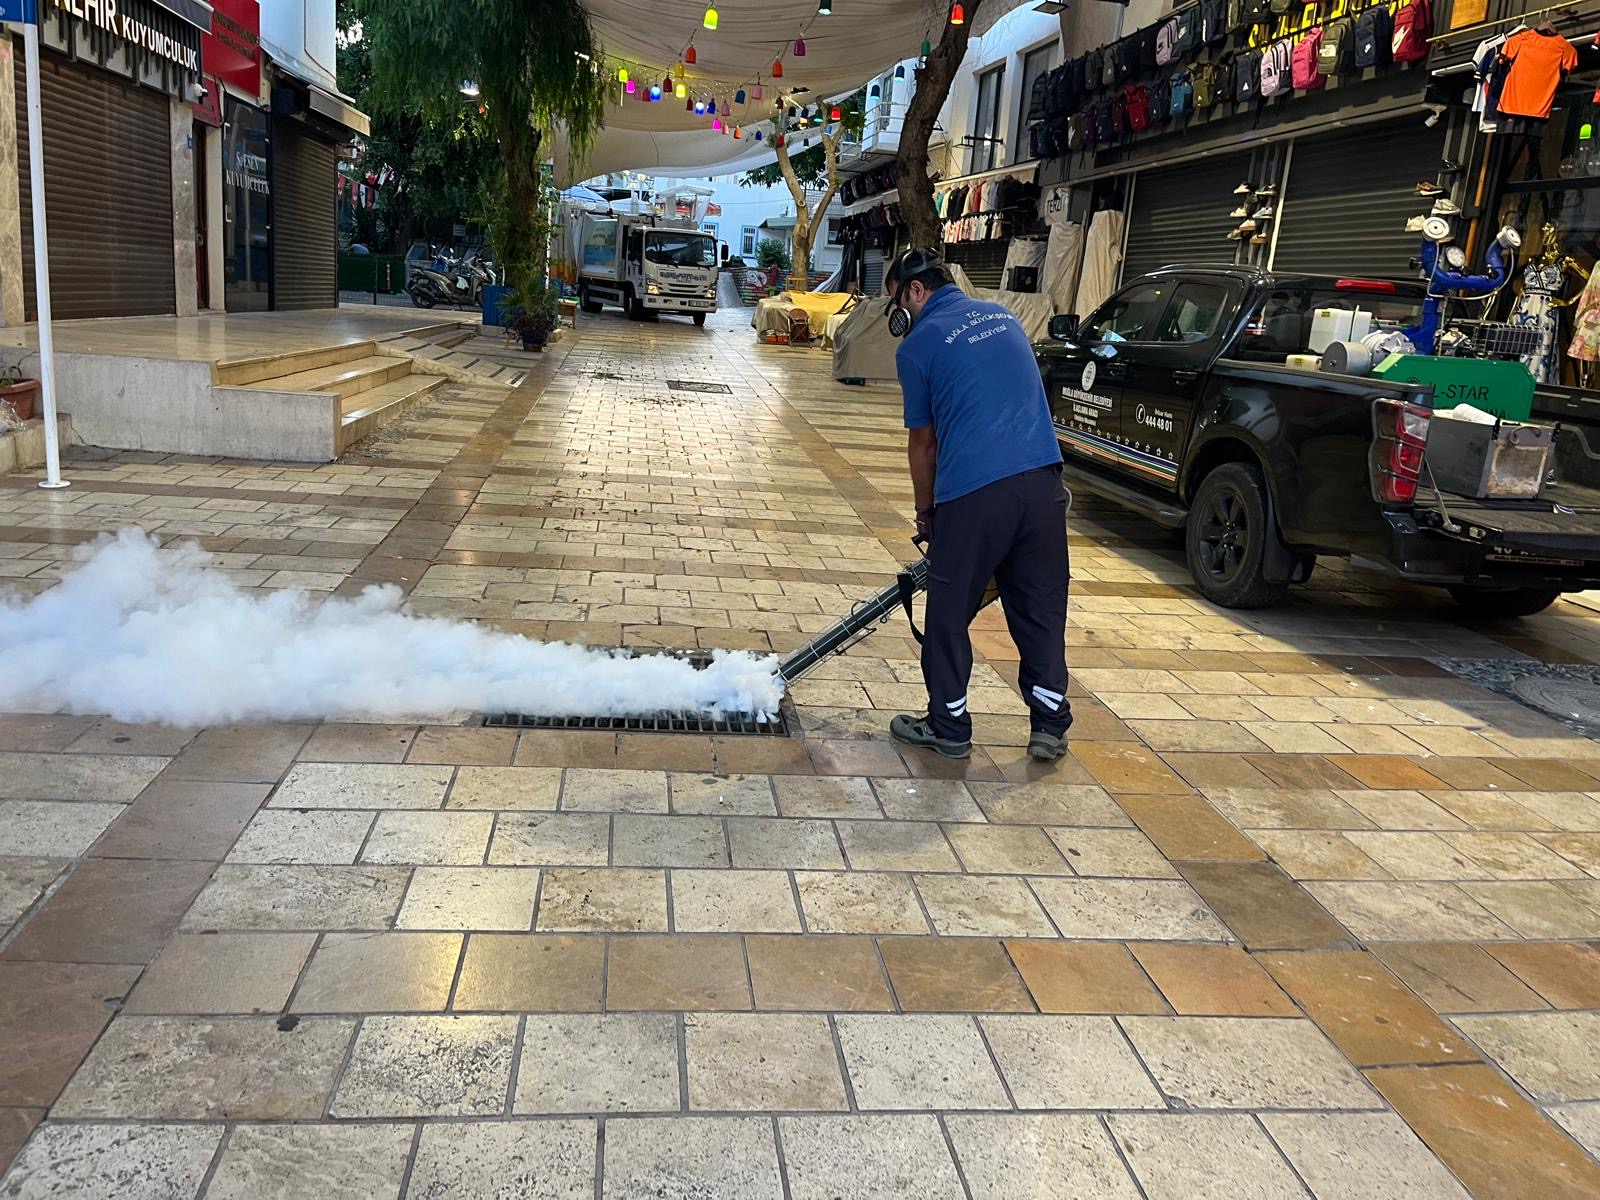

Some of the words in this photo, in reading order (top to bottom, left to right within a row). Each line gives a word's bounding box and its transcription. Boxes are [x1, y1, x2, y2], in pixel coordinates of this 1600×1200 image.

[122, 14, 198, 71] KUYUMCULUK
[967, 323, 1008, 344] BELEDİYESİ
[1145, 415, 1156, 428] 444
